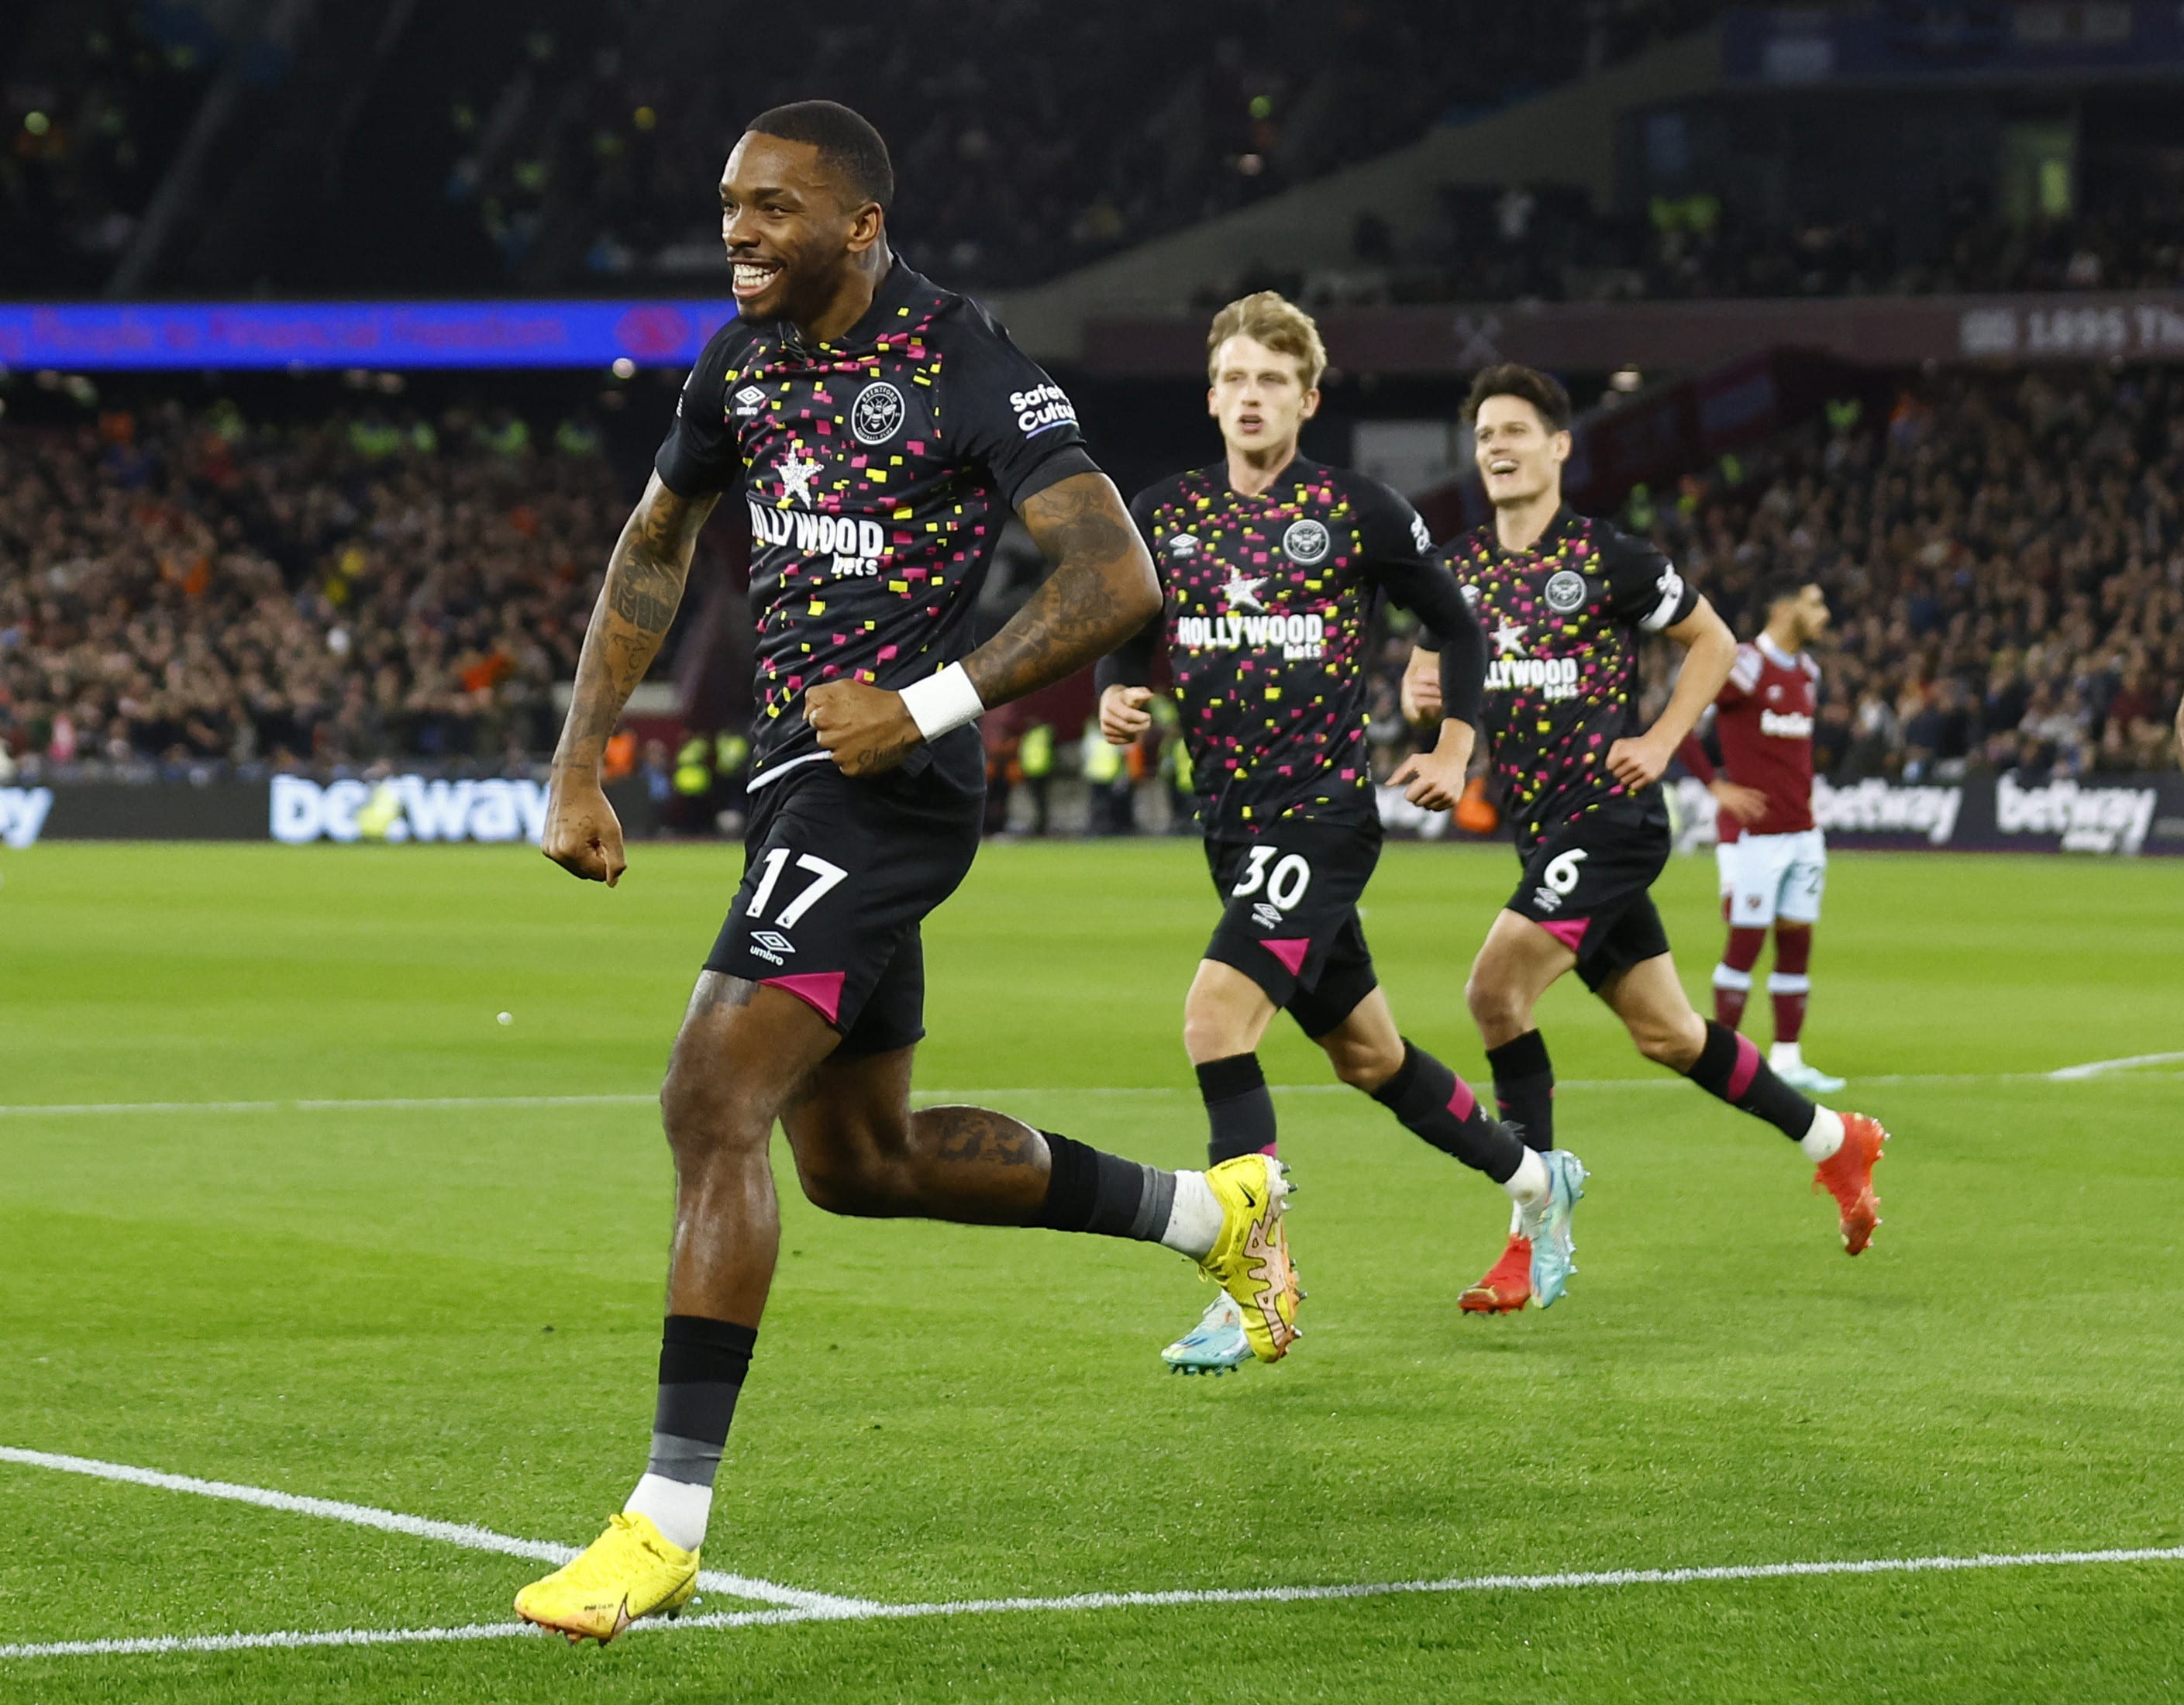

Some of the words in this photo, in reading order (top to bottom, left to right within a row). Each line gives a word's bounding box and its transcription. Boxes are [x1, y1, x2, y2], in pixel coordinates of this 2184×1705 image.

[748, 501, 884, 558] OLLYWOOD
[831, 552, 878, 577] bets
[1178, 615, 1323, 647] HOLLYWOOD
[1283, 642, 1322, 661] bets
[270, 773, 550, 845] beway
[1996, 768, 2157, 856] betway
[746, 848, 849, 929] 17
[1232, 846, 1311, 911] 30
[1544, 848, 1588, 895] 6
[749, 945, 784, 966] umbro
